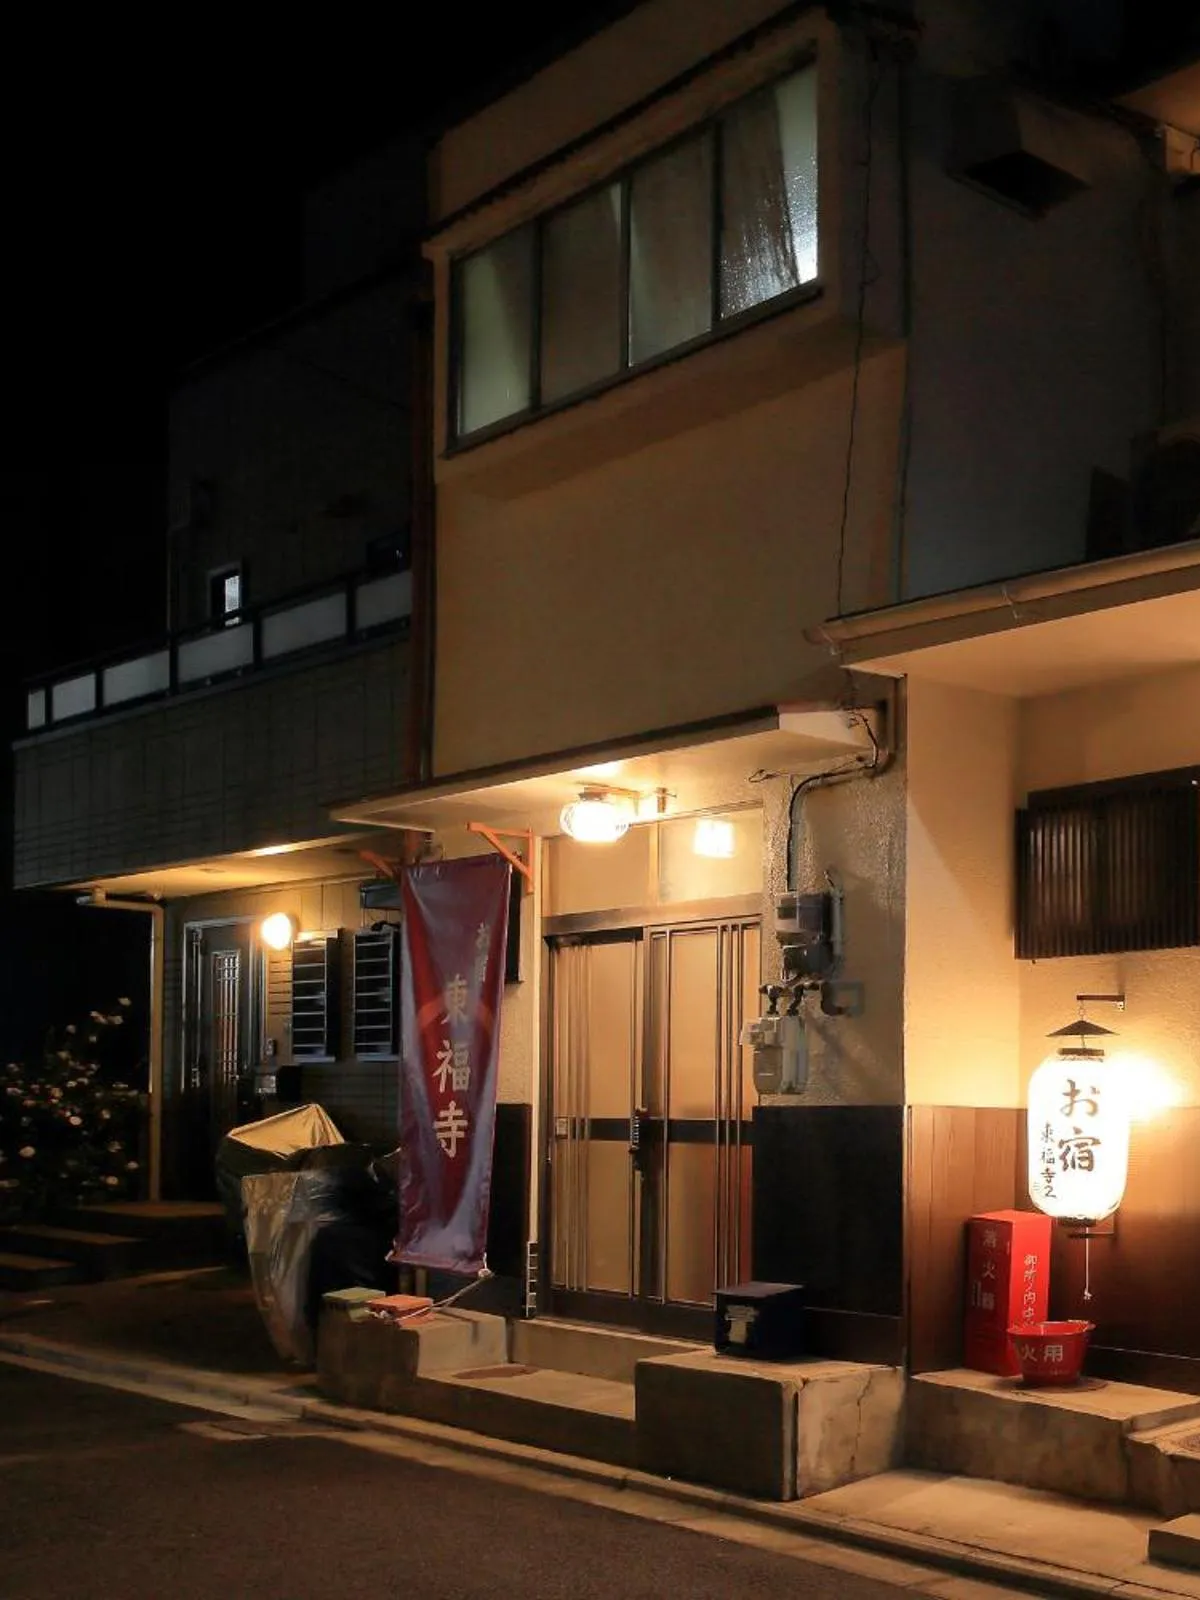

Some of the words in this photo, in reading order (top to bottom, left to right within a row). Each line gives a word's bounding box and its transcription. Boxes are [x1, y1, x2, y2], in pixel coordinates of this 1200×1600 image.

[432, 973, 471, 1159] 東福寺
[1058, 1078, 1102, 1172] お宿
